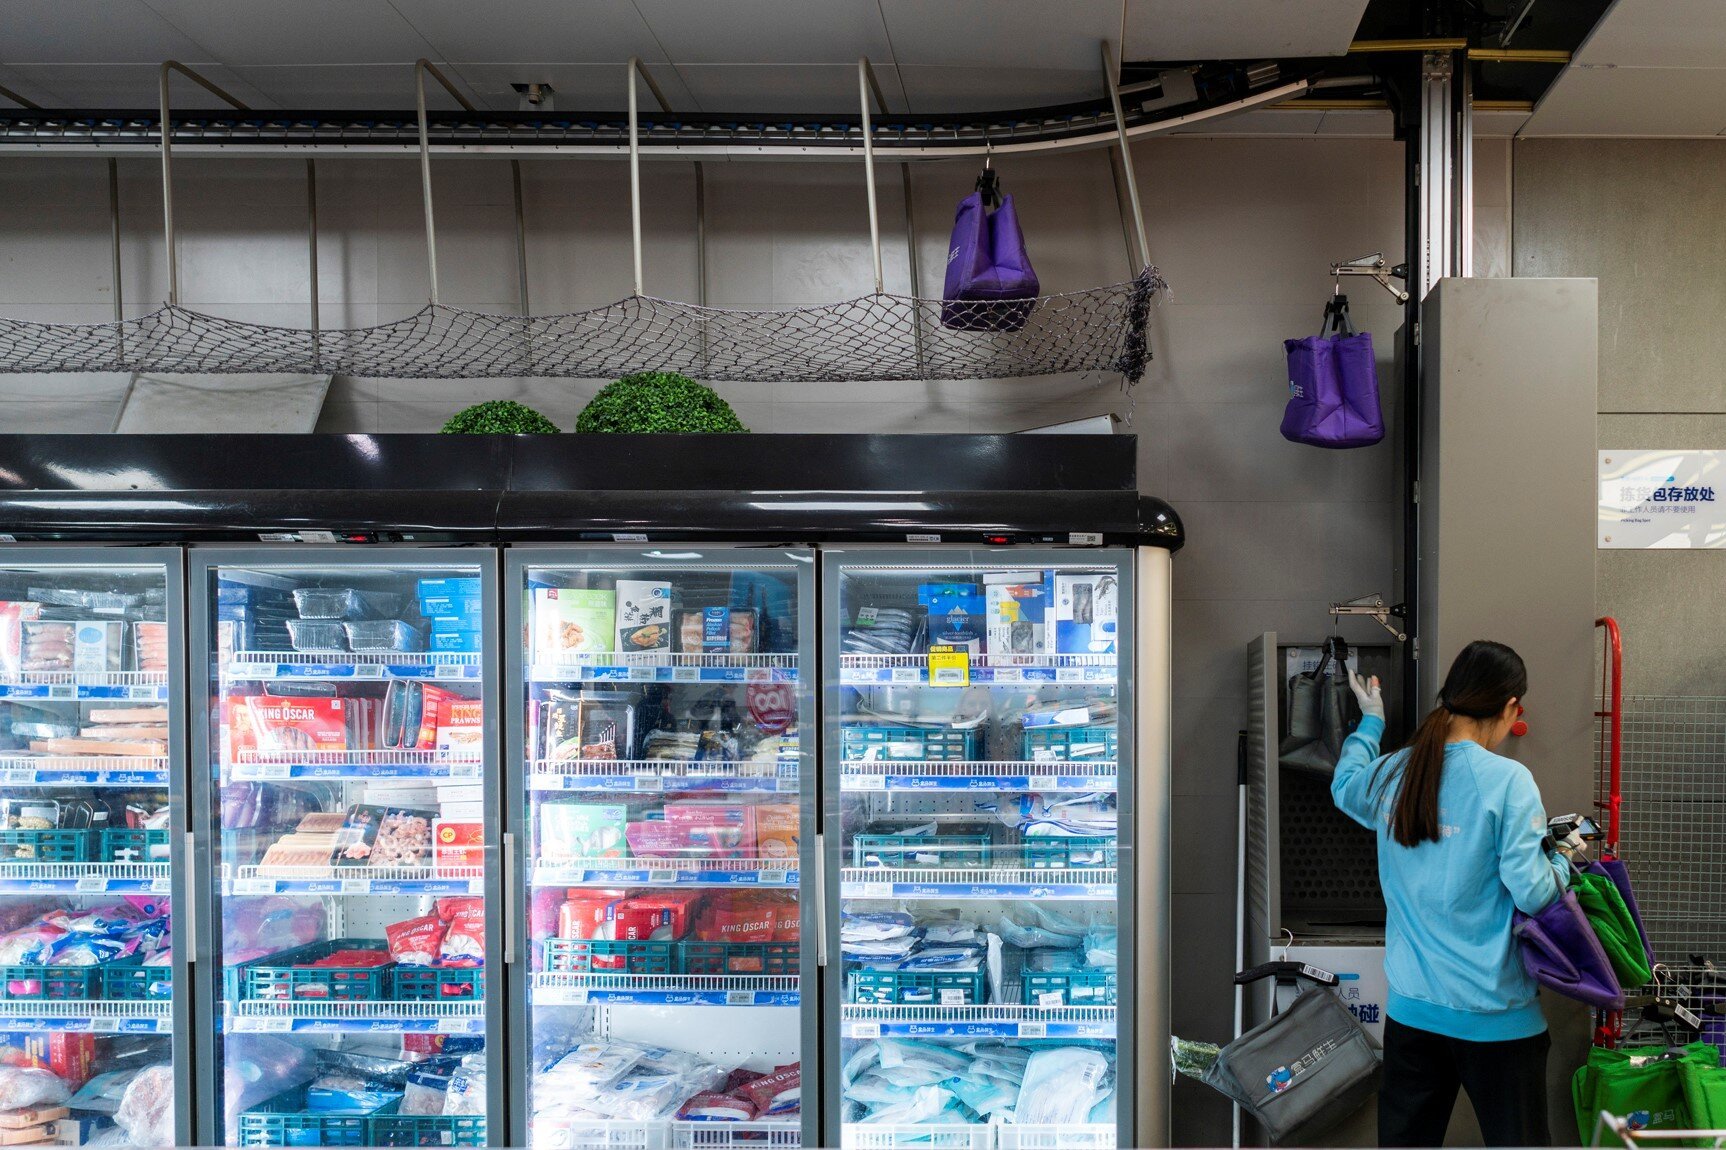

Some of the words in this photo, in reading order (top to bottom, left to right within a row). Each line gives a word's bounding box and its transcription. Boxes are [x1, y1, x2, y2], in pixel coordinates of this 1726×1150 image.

[283, 708, 315, 720] OSCAR
[452, 709, 480, 718] KING
[722, 924, 741, 933] KING
[742, 921, 770, 932] OSCAR
[1290, 1038, 1337, 1075] 盒马鲜生
[750, 1078, 775, 1089] KING
